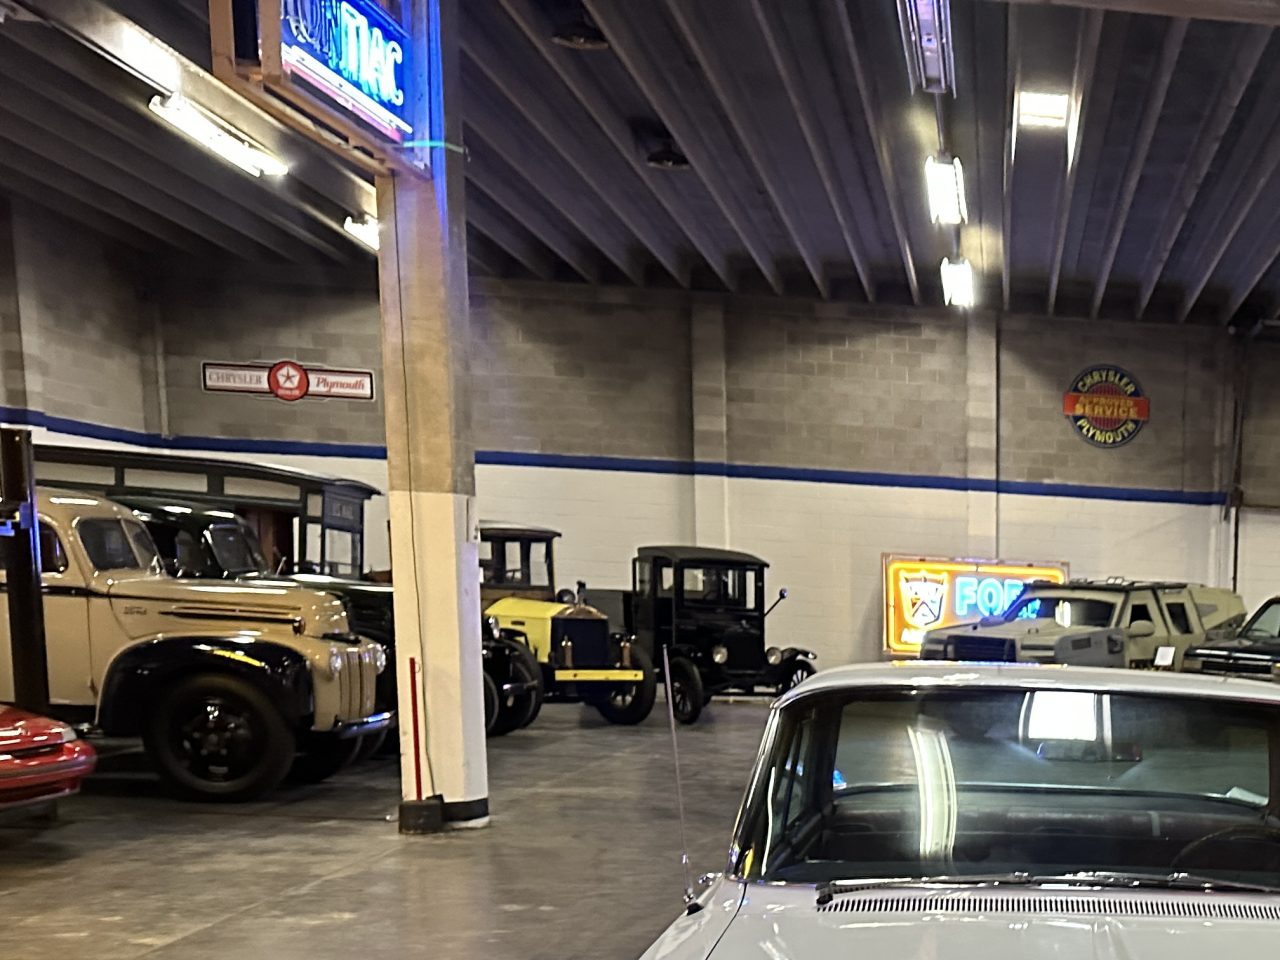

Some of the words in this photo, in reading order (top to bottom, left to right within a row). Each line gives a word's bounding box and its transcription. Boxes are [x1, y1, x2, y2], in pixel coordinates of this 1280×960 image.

[281, 0, 404, 107] ONTIAC
[208, 371, 263, 386] CHRYSLER
[315, 376, 366, 393] Plymouth
[1077, 369, 1136, 394] CHRYSLER
[1074, 403, 1138, 419] SERVICE
[1076, 418, 1136, 444] PLYMOUTH
